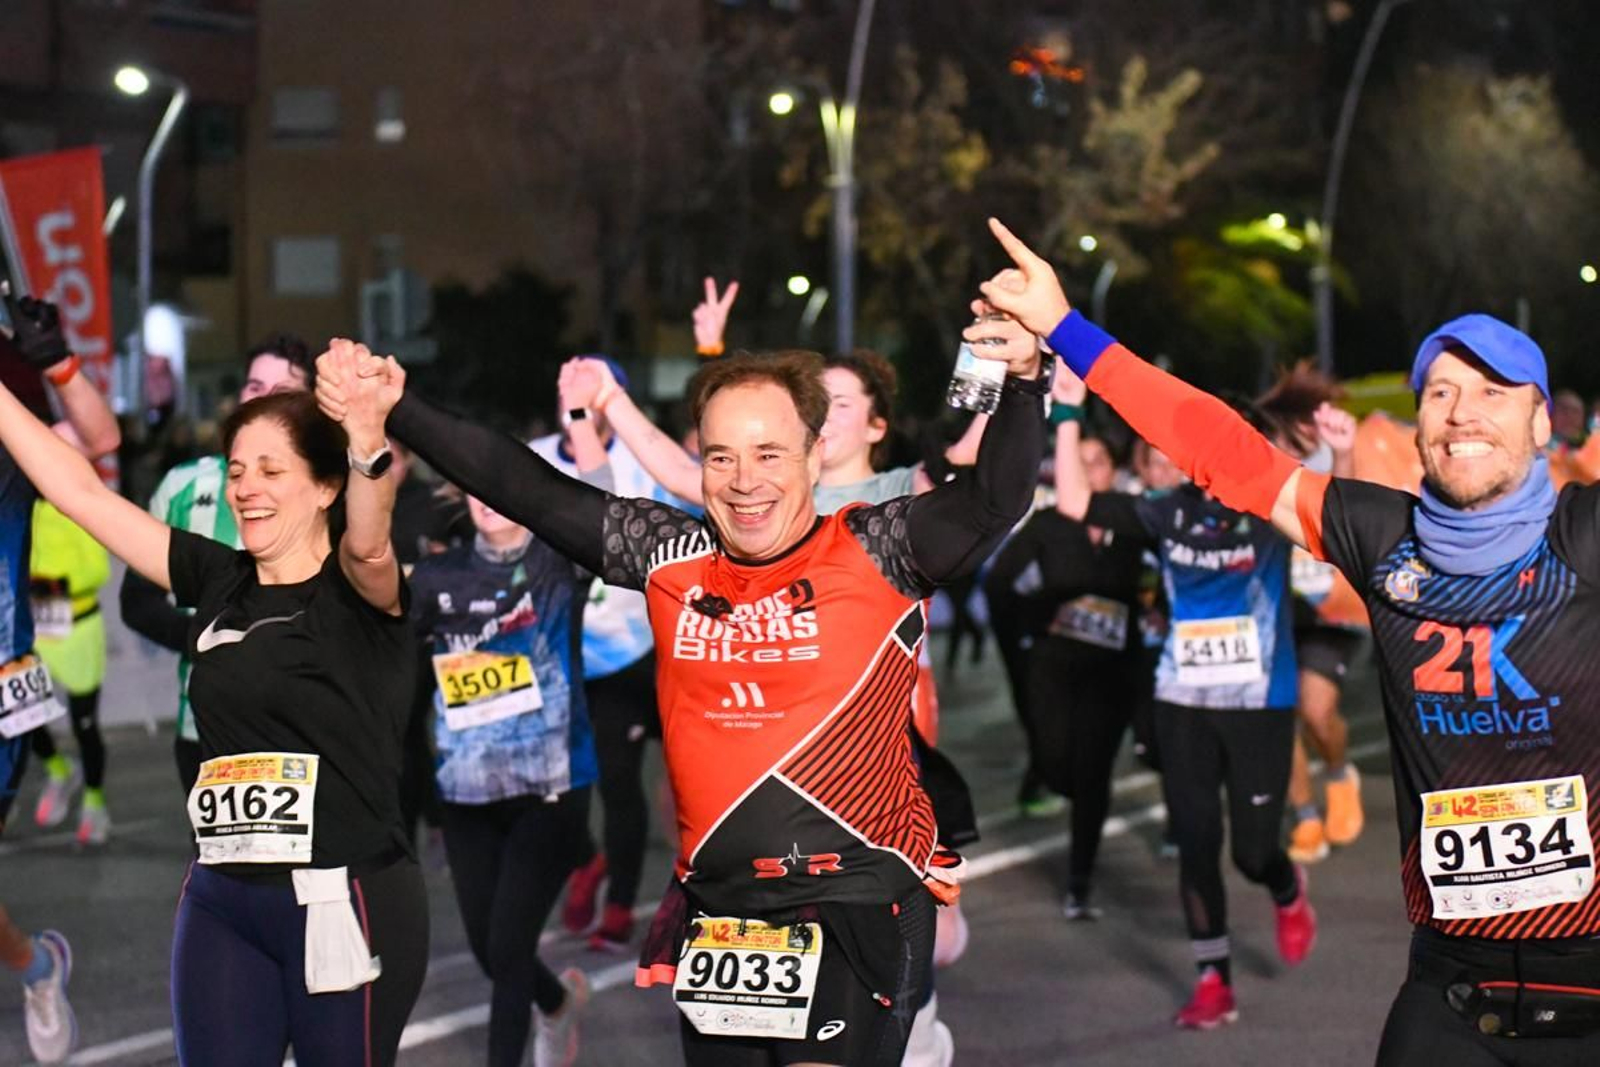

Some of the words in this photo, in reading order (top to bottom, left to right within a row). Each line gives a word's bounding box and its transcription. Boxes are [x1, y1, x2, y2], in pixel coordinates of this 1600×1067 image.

[789, 578, 816, 614] 2
[675, 610, 819, 643] RUEDAS
[673, 637, 820, 663] Bikes
[1413, 614, 1541, 701] 21K
[1416, 701, 1550, 735] Huelva
[198, 785, 299, 824] 9162
[1451, 795, 1478, 817] 42
[1434, 817, 1575, 871] 9134
[711, 923, 731, 943] 42
[687, 951, 802, 994] 9033
